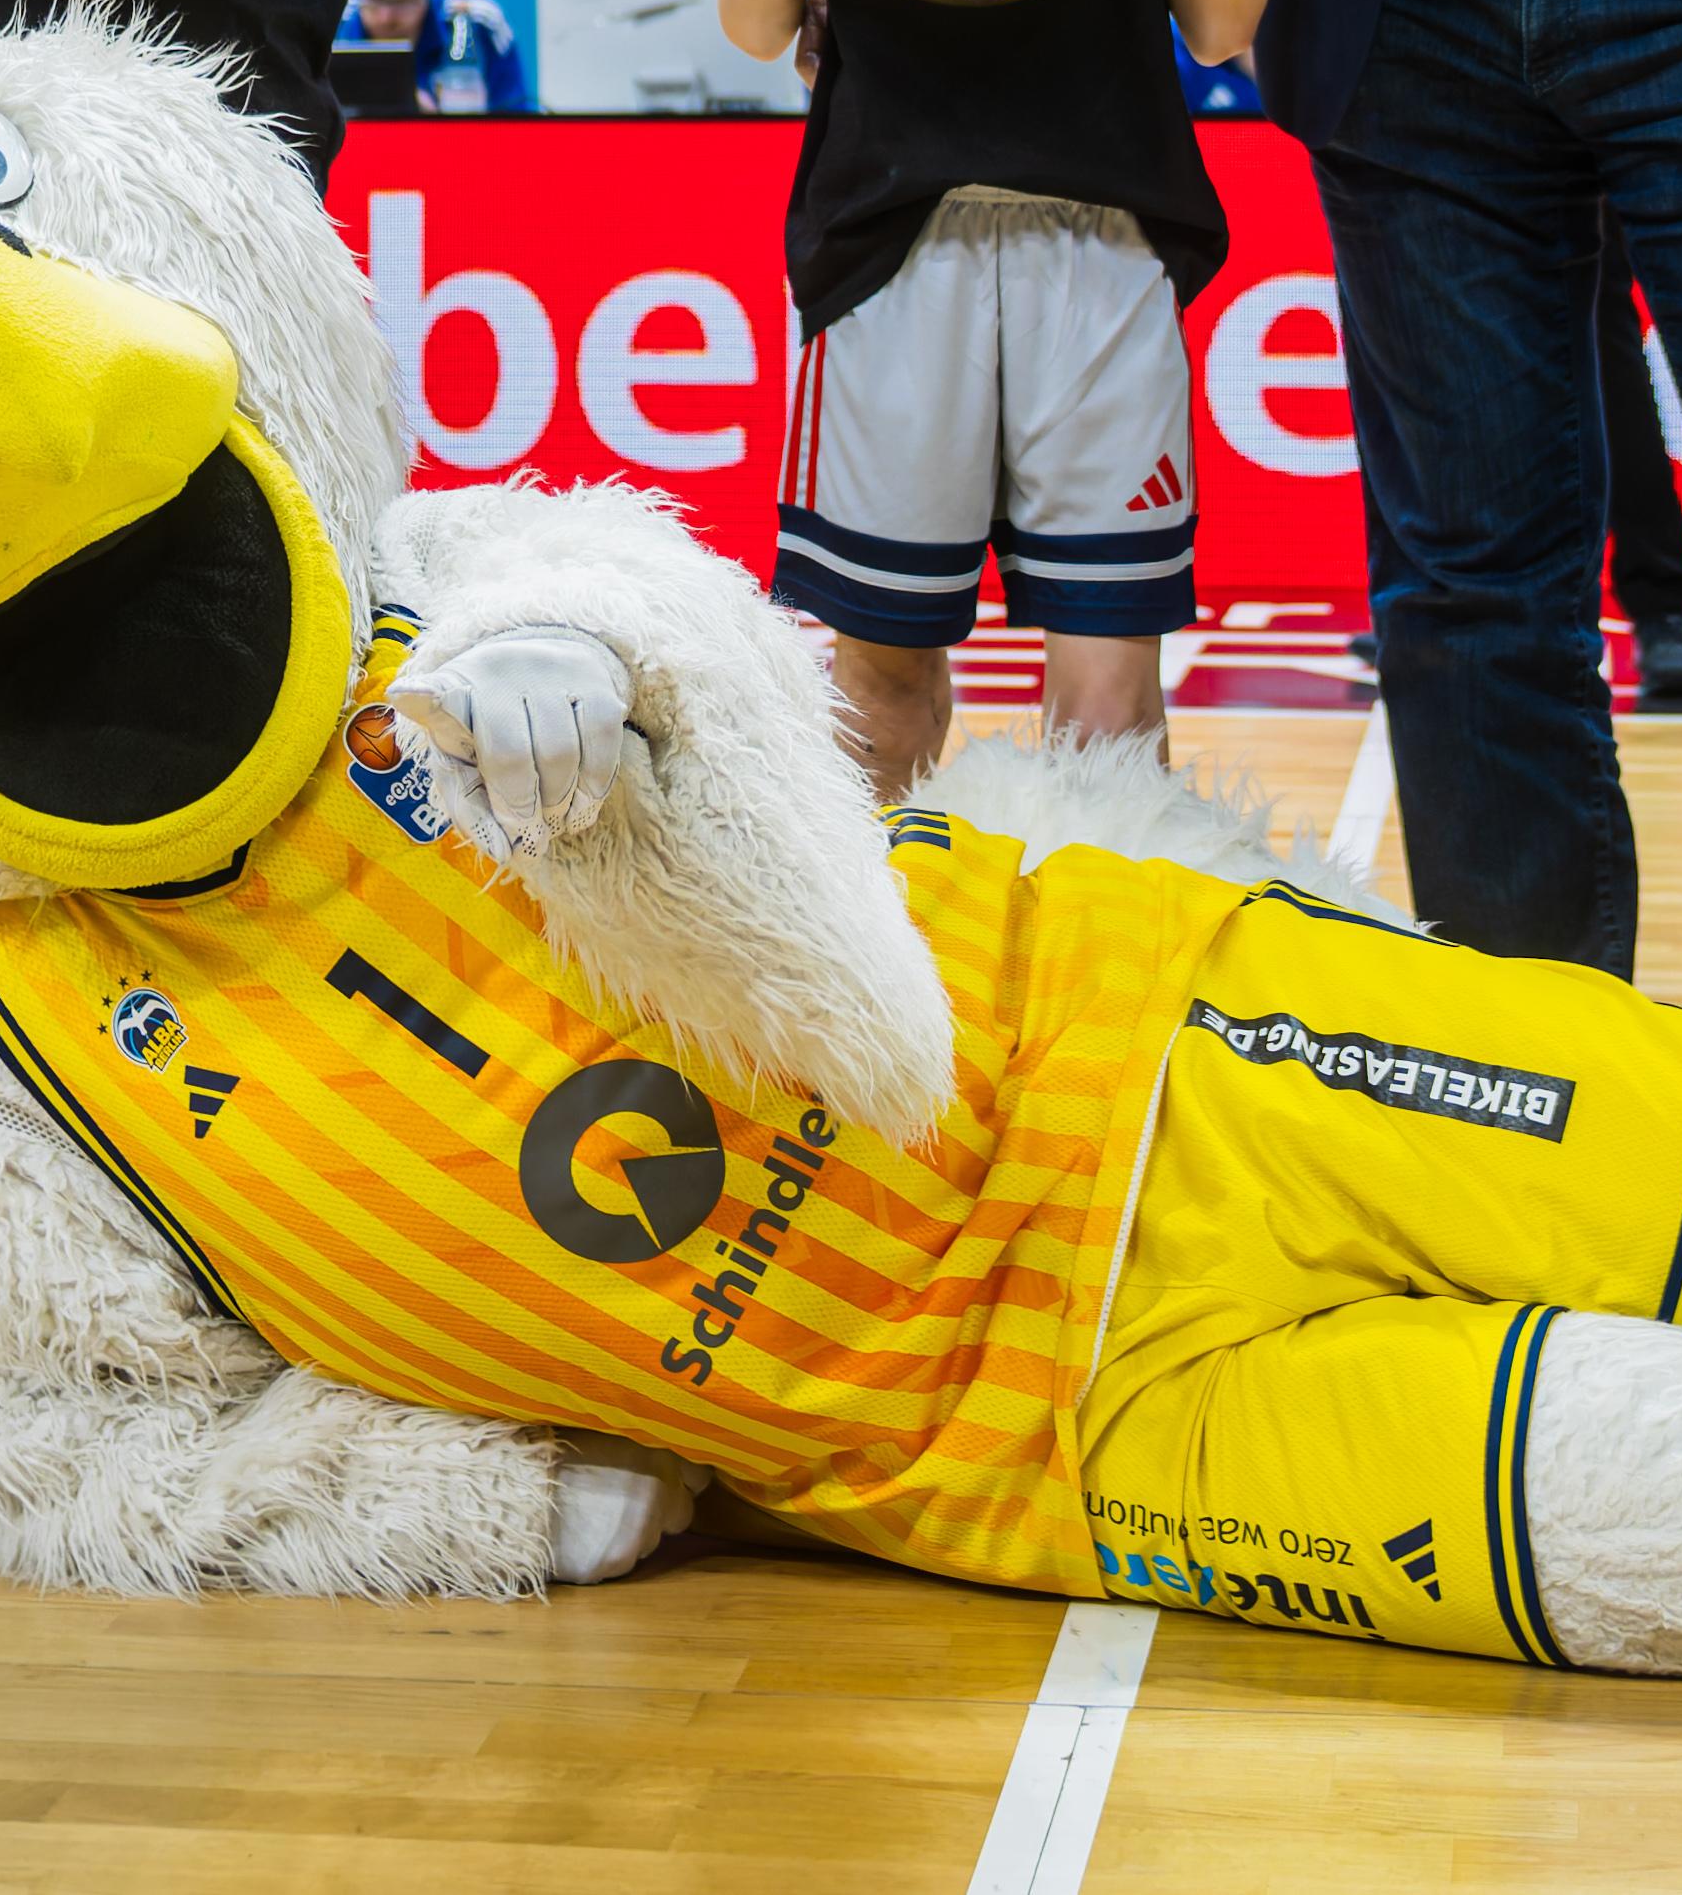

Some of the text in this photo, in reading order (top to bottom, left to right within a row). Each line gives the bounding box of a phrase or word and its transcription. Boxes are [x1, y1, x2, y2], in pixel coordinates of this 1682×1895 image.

[142, 1019, 181, 1067] ALBA
[323, 946, 492, 1080] 1
[1200, 1007, 1560, 1126] BIKELEASING.DE
[660, 1091, 840, 1388] Schindle
[1279, 1529, 1355, 1567] zero
